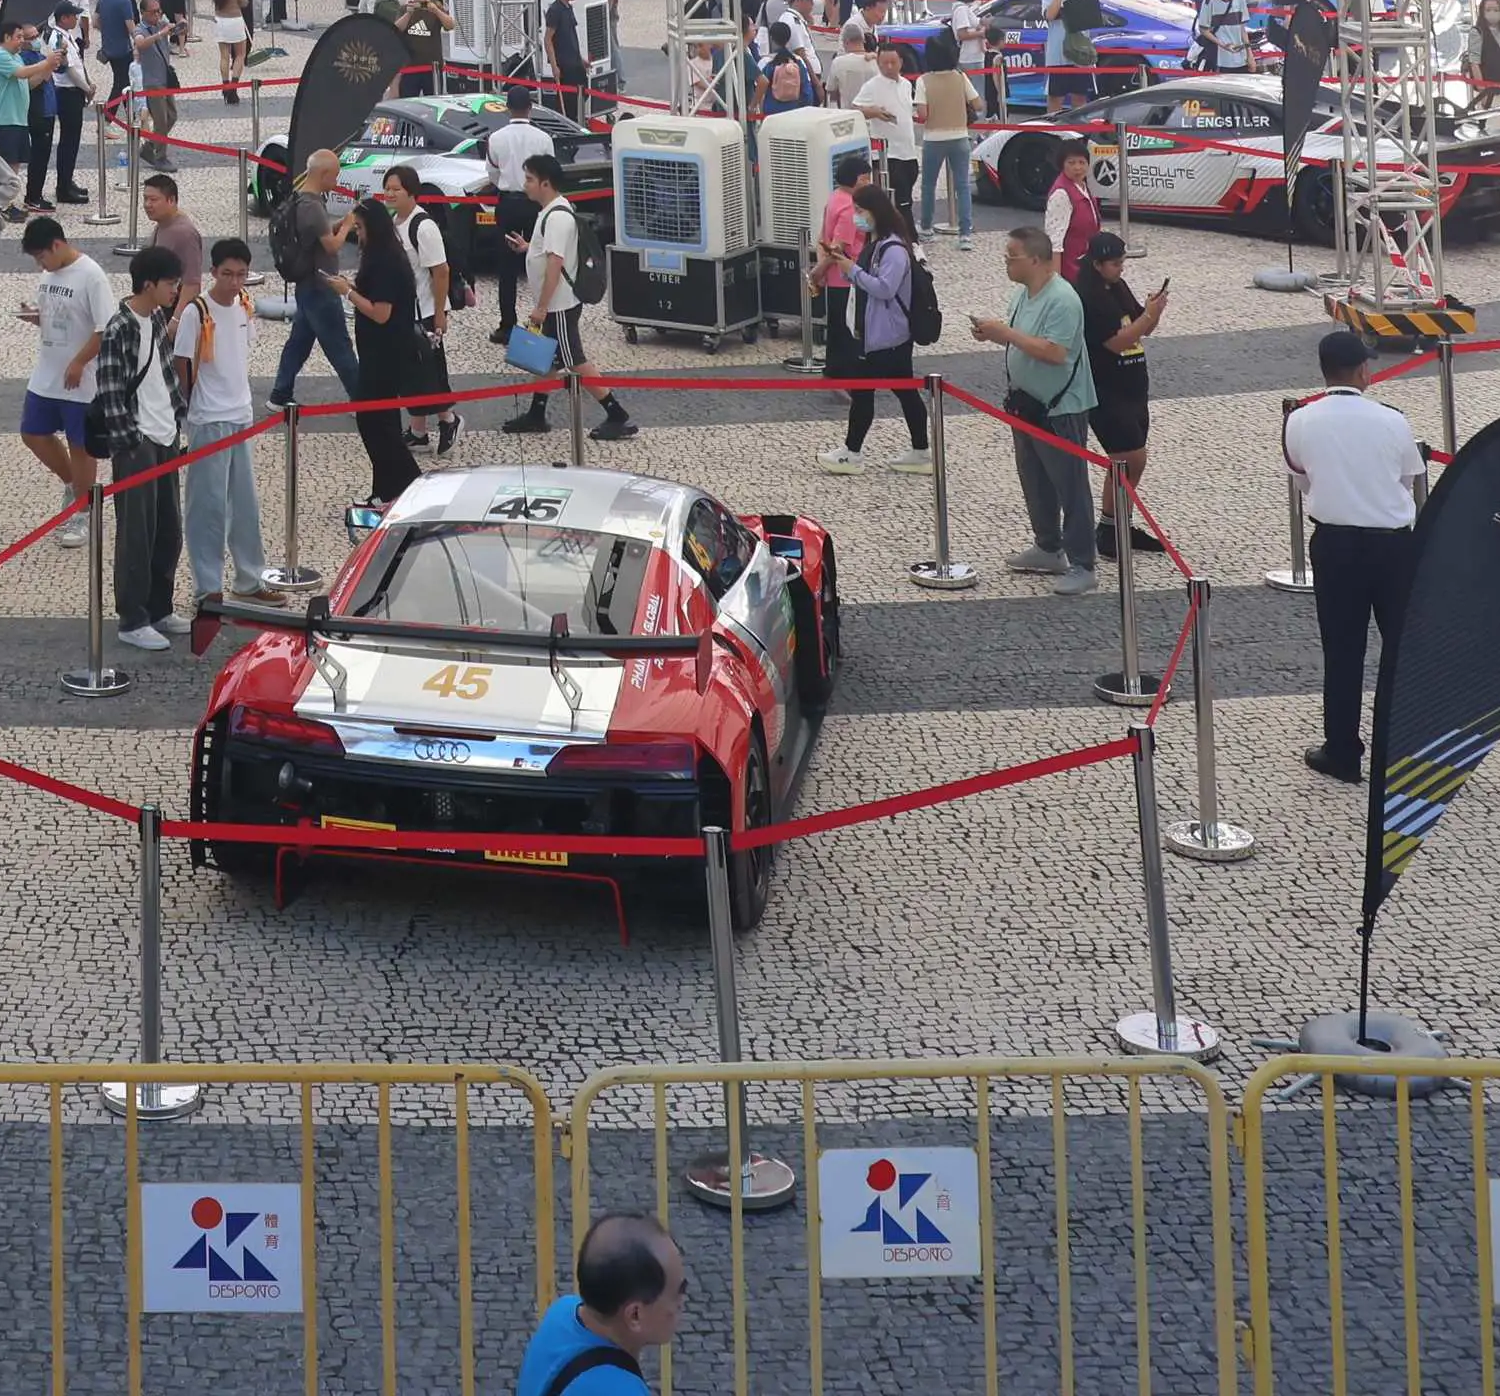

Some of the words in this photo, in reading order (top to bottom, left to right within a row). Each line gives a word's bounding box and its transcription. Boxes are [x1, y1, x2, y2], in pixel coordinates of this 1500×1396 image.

[408, 28, 431, 36] adidas
[1182, 100, 1200, 116] 19
[1196, 117, 1270, 128] ENGSTLER
[1128, 134, 1140, 149] 19
[649, 273, 681, 285] CYBER
[489, 497, 563, 522] 45
[642, 593, 663, 636] GLOBAL
[422, 665, 493, 701] 45
[264, 1211, 279, 1251] 體育
[883, 1246, 953, 1263] DESPORTO
[209, 1283, 280, 1299] DESPORTO
